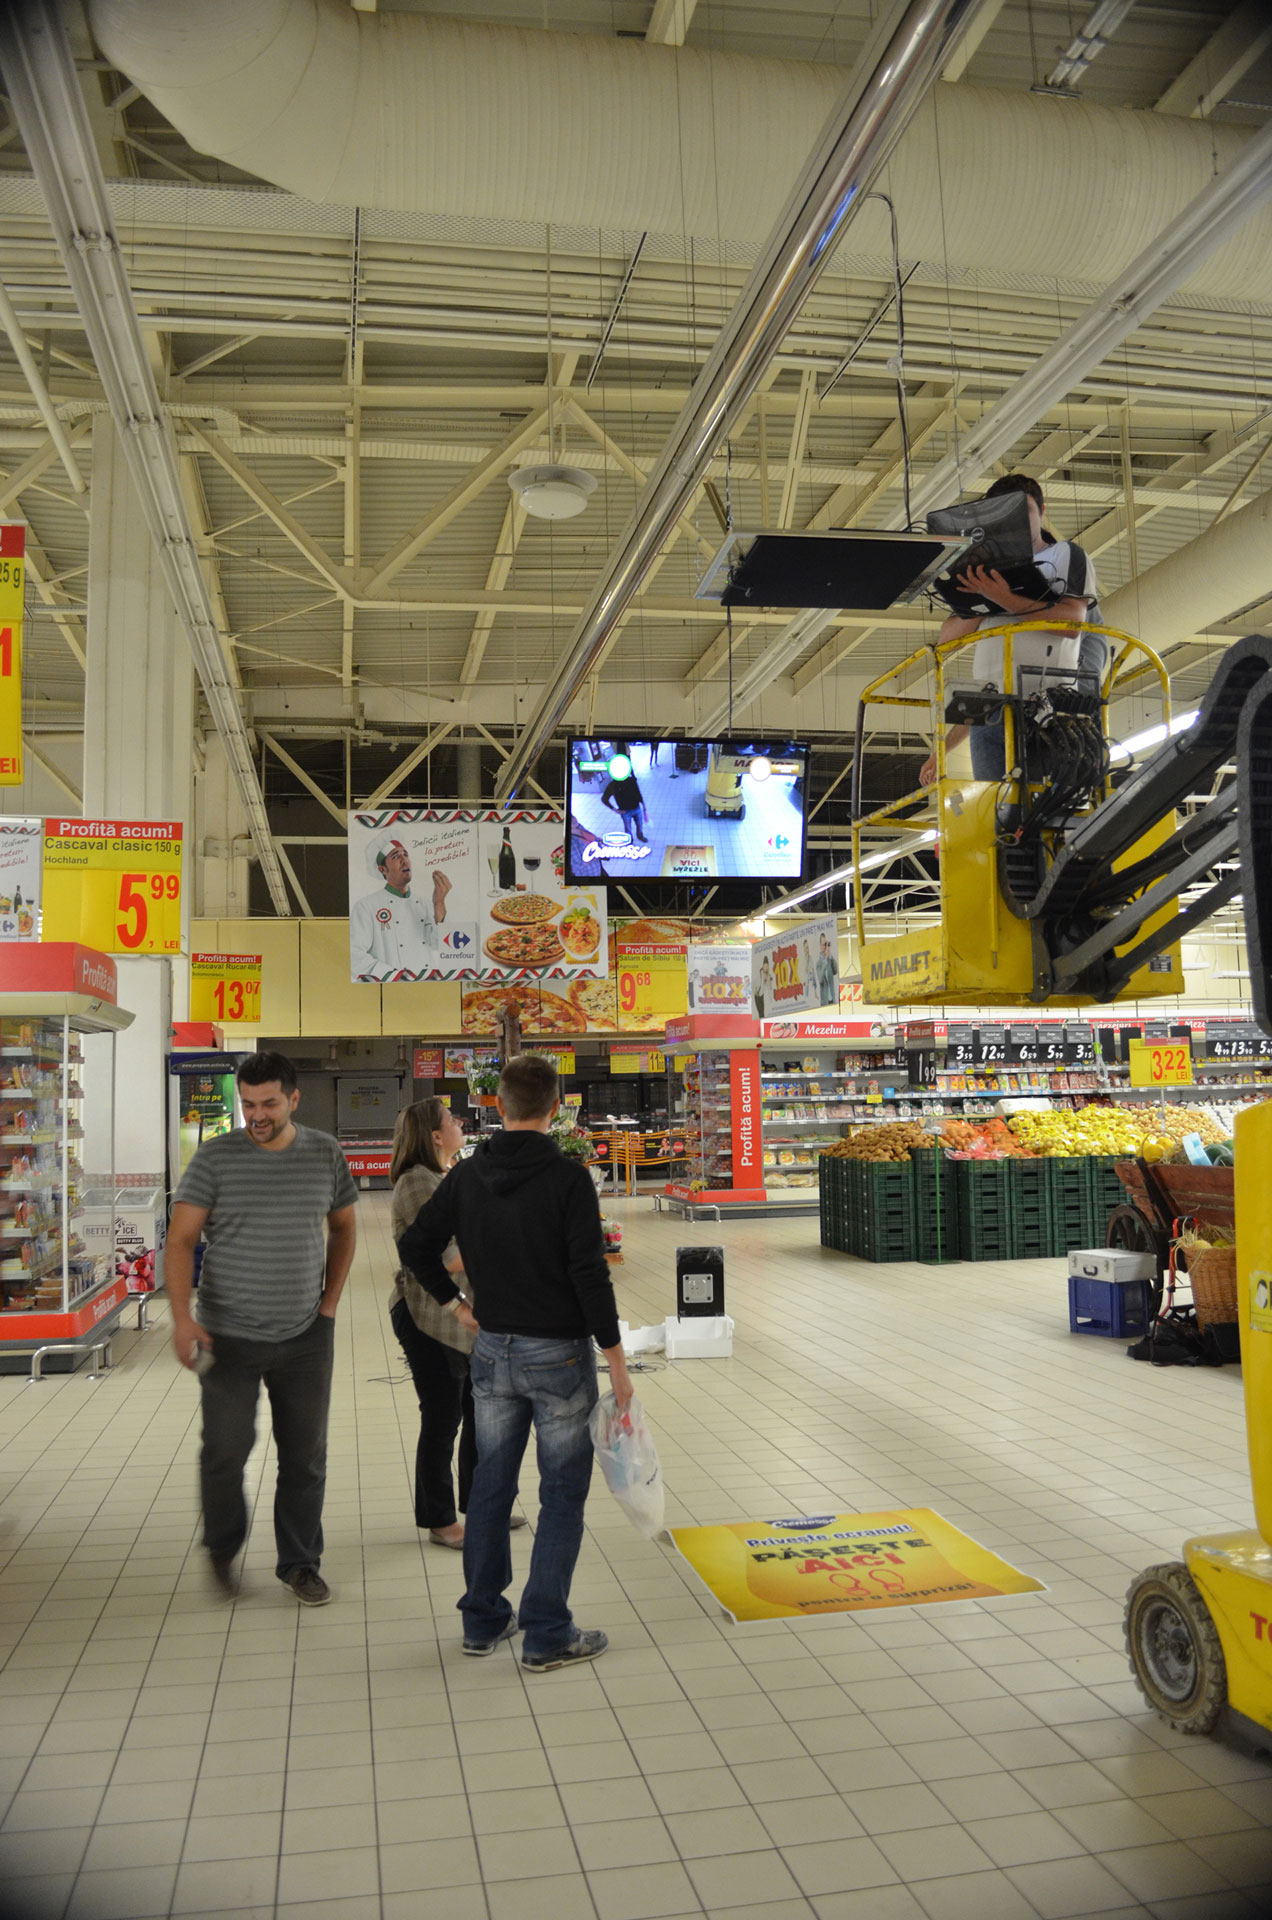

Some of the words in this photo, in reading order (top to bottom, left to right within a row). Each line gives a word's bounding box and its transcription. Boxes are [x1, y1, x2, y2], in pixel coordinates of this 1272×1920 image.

[13, 567, 20, 589] g
[59, 821, 116, 837] Profită
[120, 824, 174, 838] acum!
[412, 834, 438, 849] Delicii
[441, 829, 470, 840] italiene
[44, 837, 108, 851] Cascaval
[112, 839, 152, 852] clasic
[155, 841, 171, 853] 150
[173, 844, 181, 856] g
[425, 847, 433, 856] la
[44, 855, 88, 865] Hochland
[164, 941, 179, 949] LEI
[655, 946, 682, 954] acum!
[229, 955, 257, 963] acum!
[440, 952, 475, 960] Carrefour
[871, 950, 931, 982] MANLIFT
[804, 1024, 847, 1035] Mezeluri
[1176, 1072, 1188, 1080] LEI
[738, 1067, 753, 1113] acum!
[211, 1094, 222, 1103] pe
[740, 1116, 754, 1167] Profită
[85, 1227, 110, 1236] BETTY
[122, 1226, 136, 1235] ICE
[771, 1517, 838, 1529] Cremosso
[832, 1524, 916, 1541] ecranul!
[797, 1553, 906, 1575] AICI
[798, 1596, 864, 1608] pentru
[889, 1582, 976, 1602] surpriză!
[1249, 1610, 1272, 1647] T
